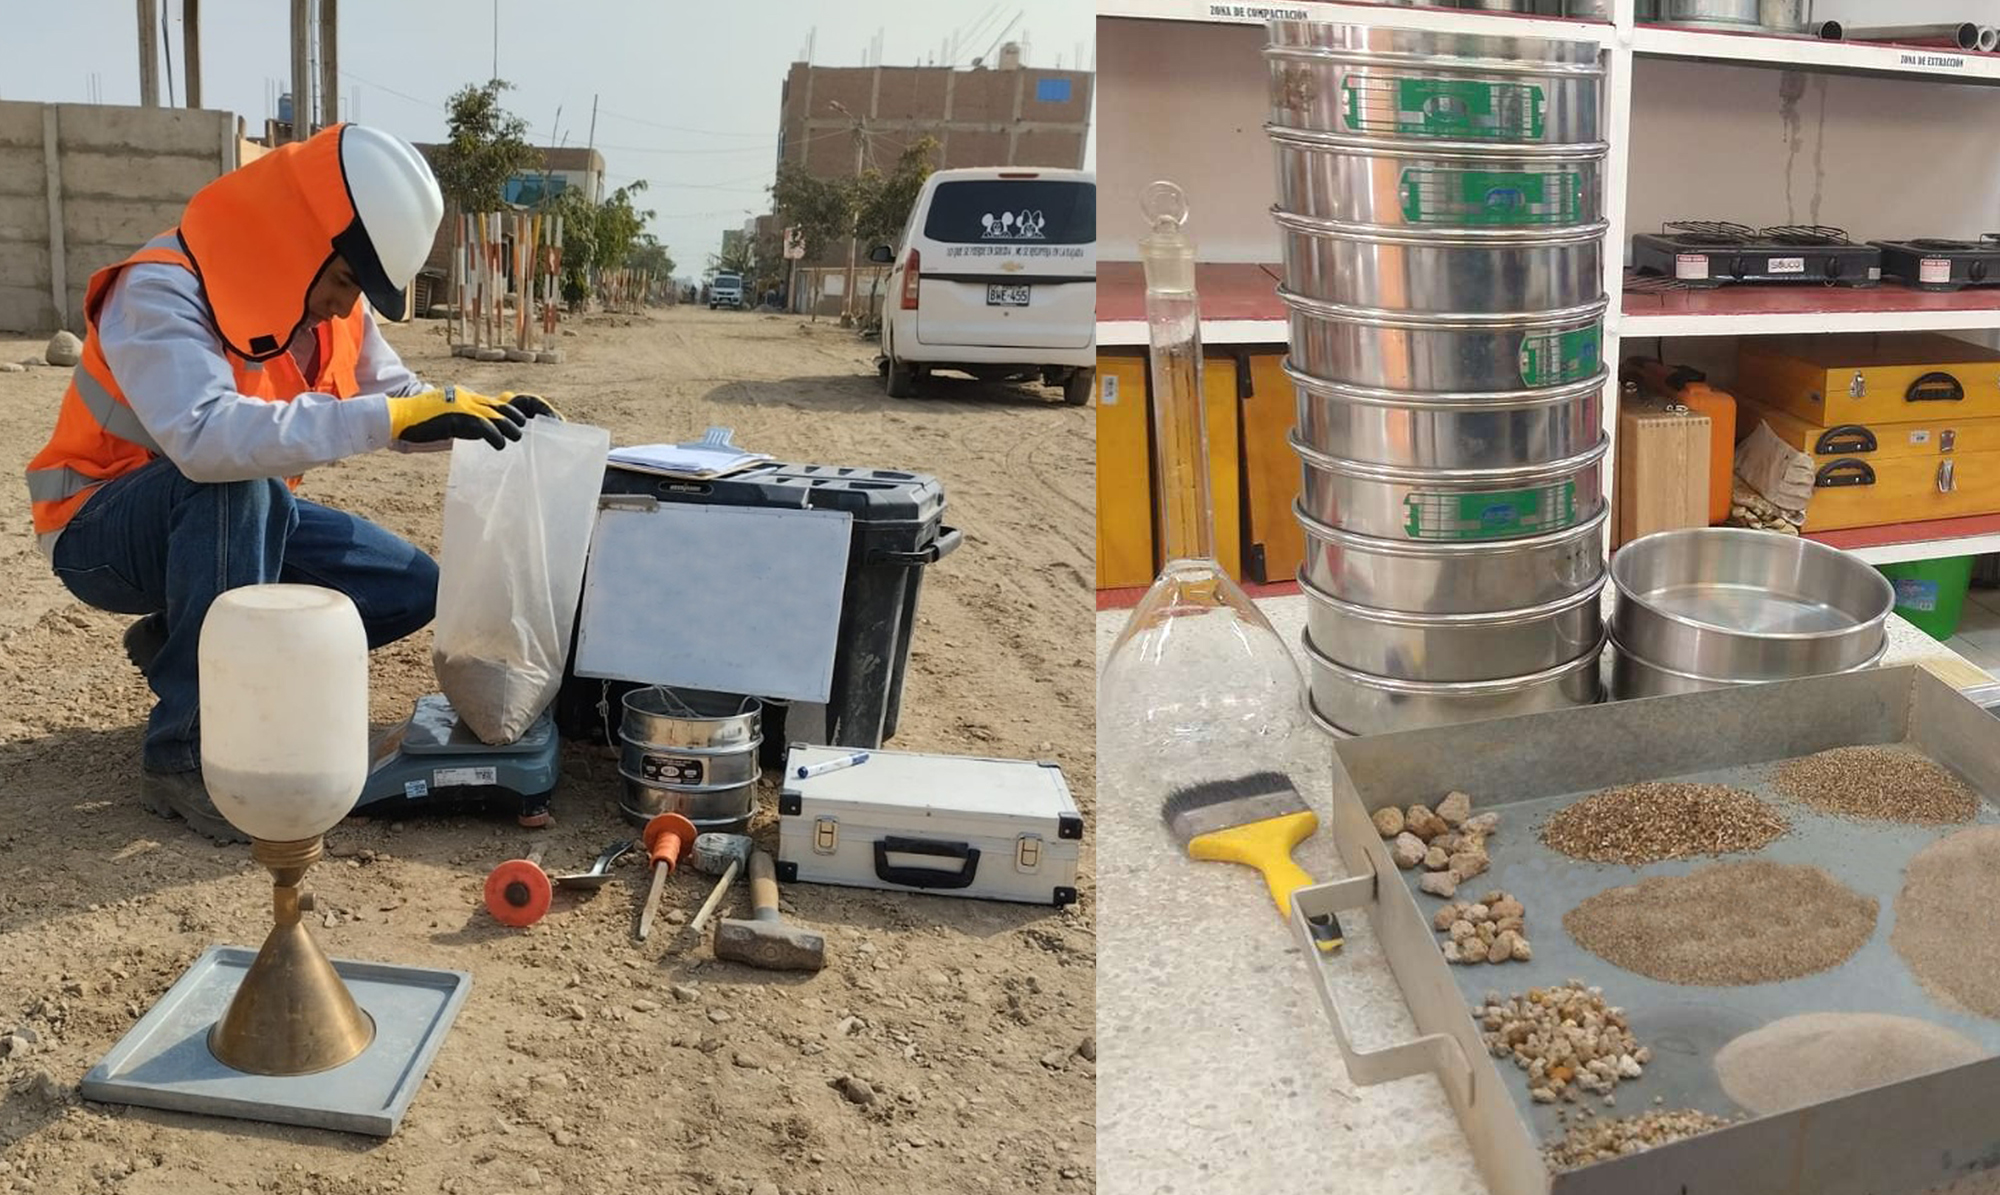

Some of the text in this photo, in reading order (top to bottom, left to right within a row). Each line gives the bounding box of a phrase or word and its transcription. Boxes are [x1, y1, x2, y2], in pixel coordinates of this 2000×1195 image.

[1210, 5, 1231, 16] ZONA
[1233, 7, 1245, 17] DE
[1901, 54, 1916, 65] ZONA
[1917, 55, 1926, 66] DE
[990, 289, 1028, 302] BWE-455
